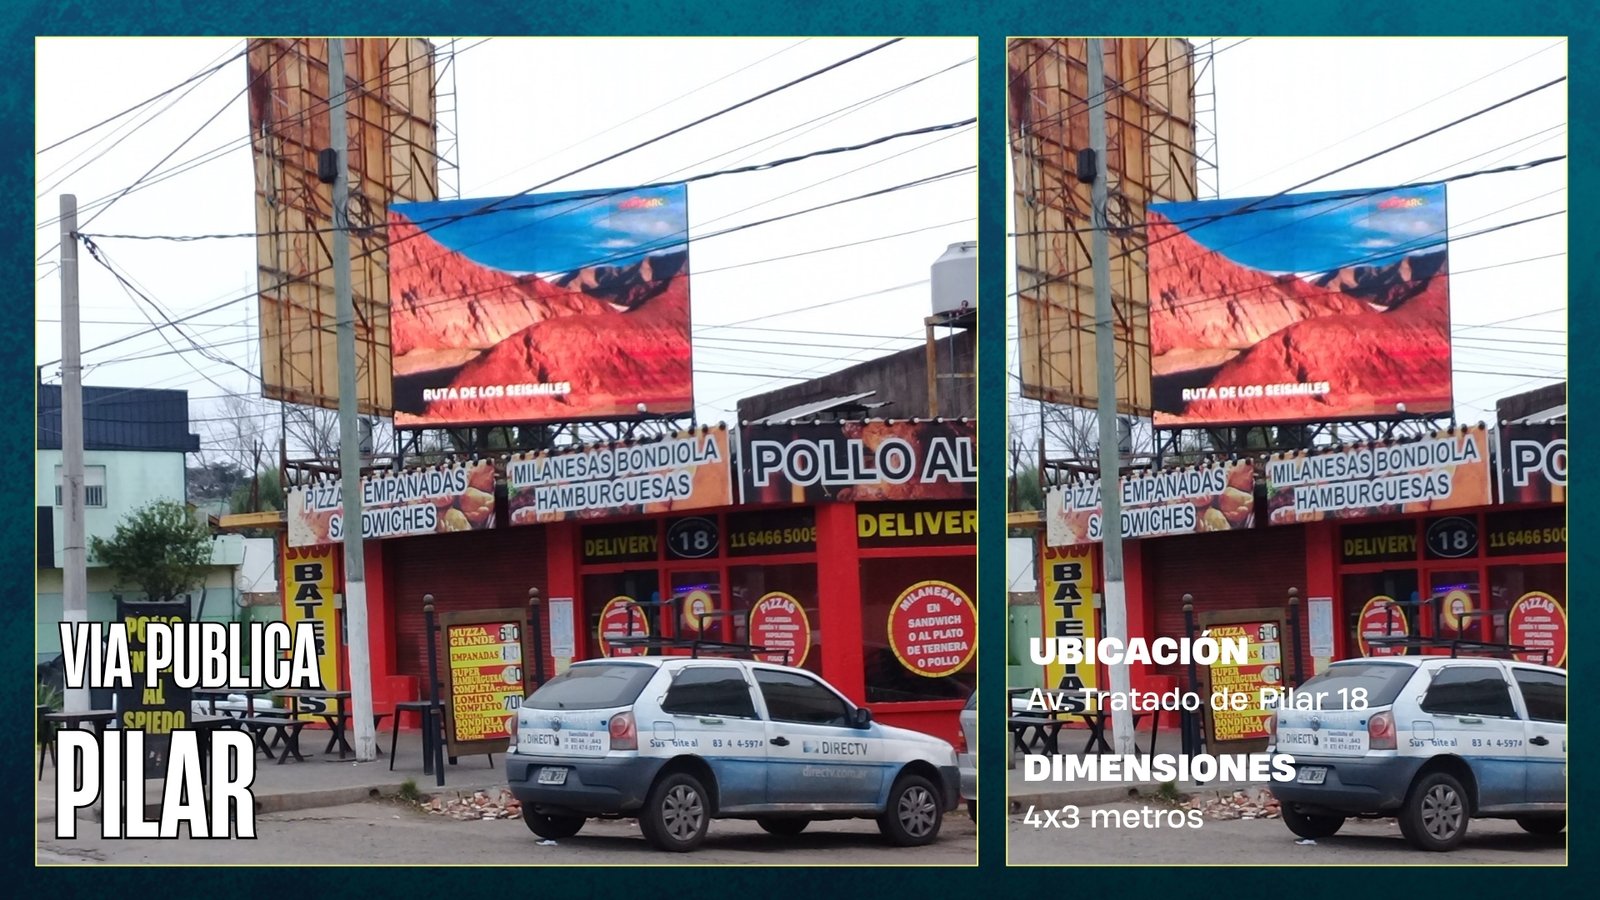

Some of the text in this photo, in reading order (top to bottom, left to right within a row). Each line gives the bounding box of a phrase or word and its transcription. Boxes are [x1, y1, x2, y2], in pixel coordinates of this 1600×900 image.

[423, 381, 571, 401] RUTA DE LOS SEISMILES
[1182, 381, 1330, 401] RUTA DE LOS SEISMILES
[514, 438, 718, 484] MILANESAS BONDIOLA
[752, 438, 916, 487] POLLO
[1273, 438, 1477, 484] MILANESAS BONDIOLA
[363, 469, 466, 504] EMPANADAS
[537, 474, 690, 510] HAMBURGUESAS
[1122, 469, 1225, 504] EMPANADAS
[1296, 474, 1449, 510] HAMBURGUESAS
[330, 508, 436, 538] SDWICHES
[1089, 508, 1195, 538] SDWICHES
[585, 535, 658, 557] DELIVERY
[679, 530, 709, 551] 18
[730, 532, 747, 548] 11
[748, 529, 782, 546] 6466
[1344, 535, 1417, 557] DELIVERY
[1438, 530, 1468, 551] 18
[1489, 532, 1506, 548] 11
[1507, 529, 1541, 546] 6466
[760, 598, 795, 614] PIZZAS
[900, 587, 963, 611] MILANESAS
[1519, 598, 1554, 614] PIZZAS
[926, 603, 941, 613] EN
[908, 615, 962, 628] SANDWICH
[450, 627, 487, 638] MUZZA
[450, 635, 496, 646] GRANDE
[908, 628, 964, 641] O AL PLATO
[452, 650, 499, 661] EMPANADAS
[907, 641, 968, 655] DE TERNERA
[917, 655, 960, 667] O POLLO
[452, 667, 480, 677] SUPER
[1211, 667, 1239, 677] SUPER
[453, 684, 496, 694] COMPLETA
[454, 694, 494, 705] LOMITO
[455, 702, 502, 713] COMPLETO
[123, 711, 185, 734] SPIEDO
[456, 717, 503, 728] BONDIOLA
[456, 724, 504, 735] COMPLETO
[1215, 717, 1262, 728] BONDIOLA
[1215, 724, 1263, 735] COMPLETO
[822, 742, 868, 755] DIRECTV
[803, 766, 867, 778] directv.com.ar
